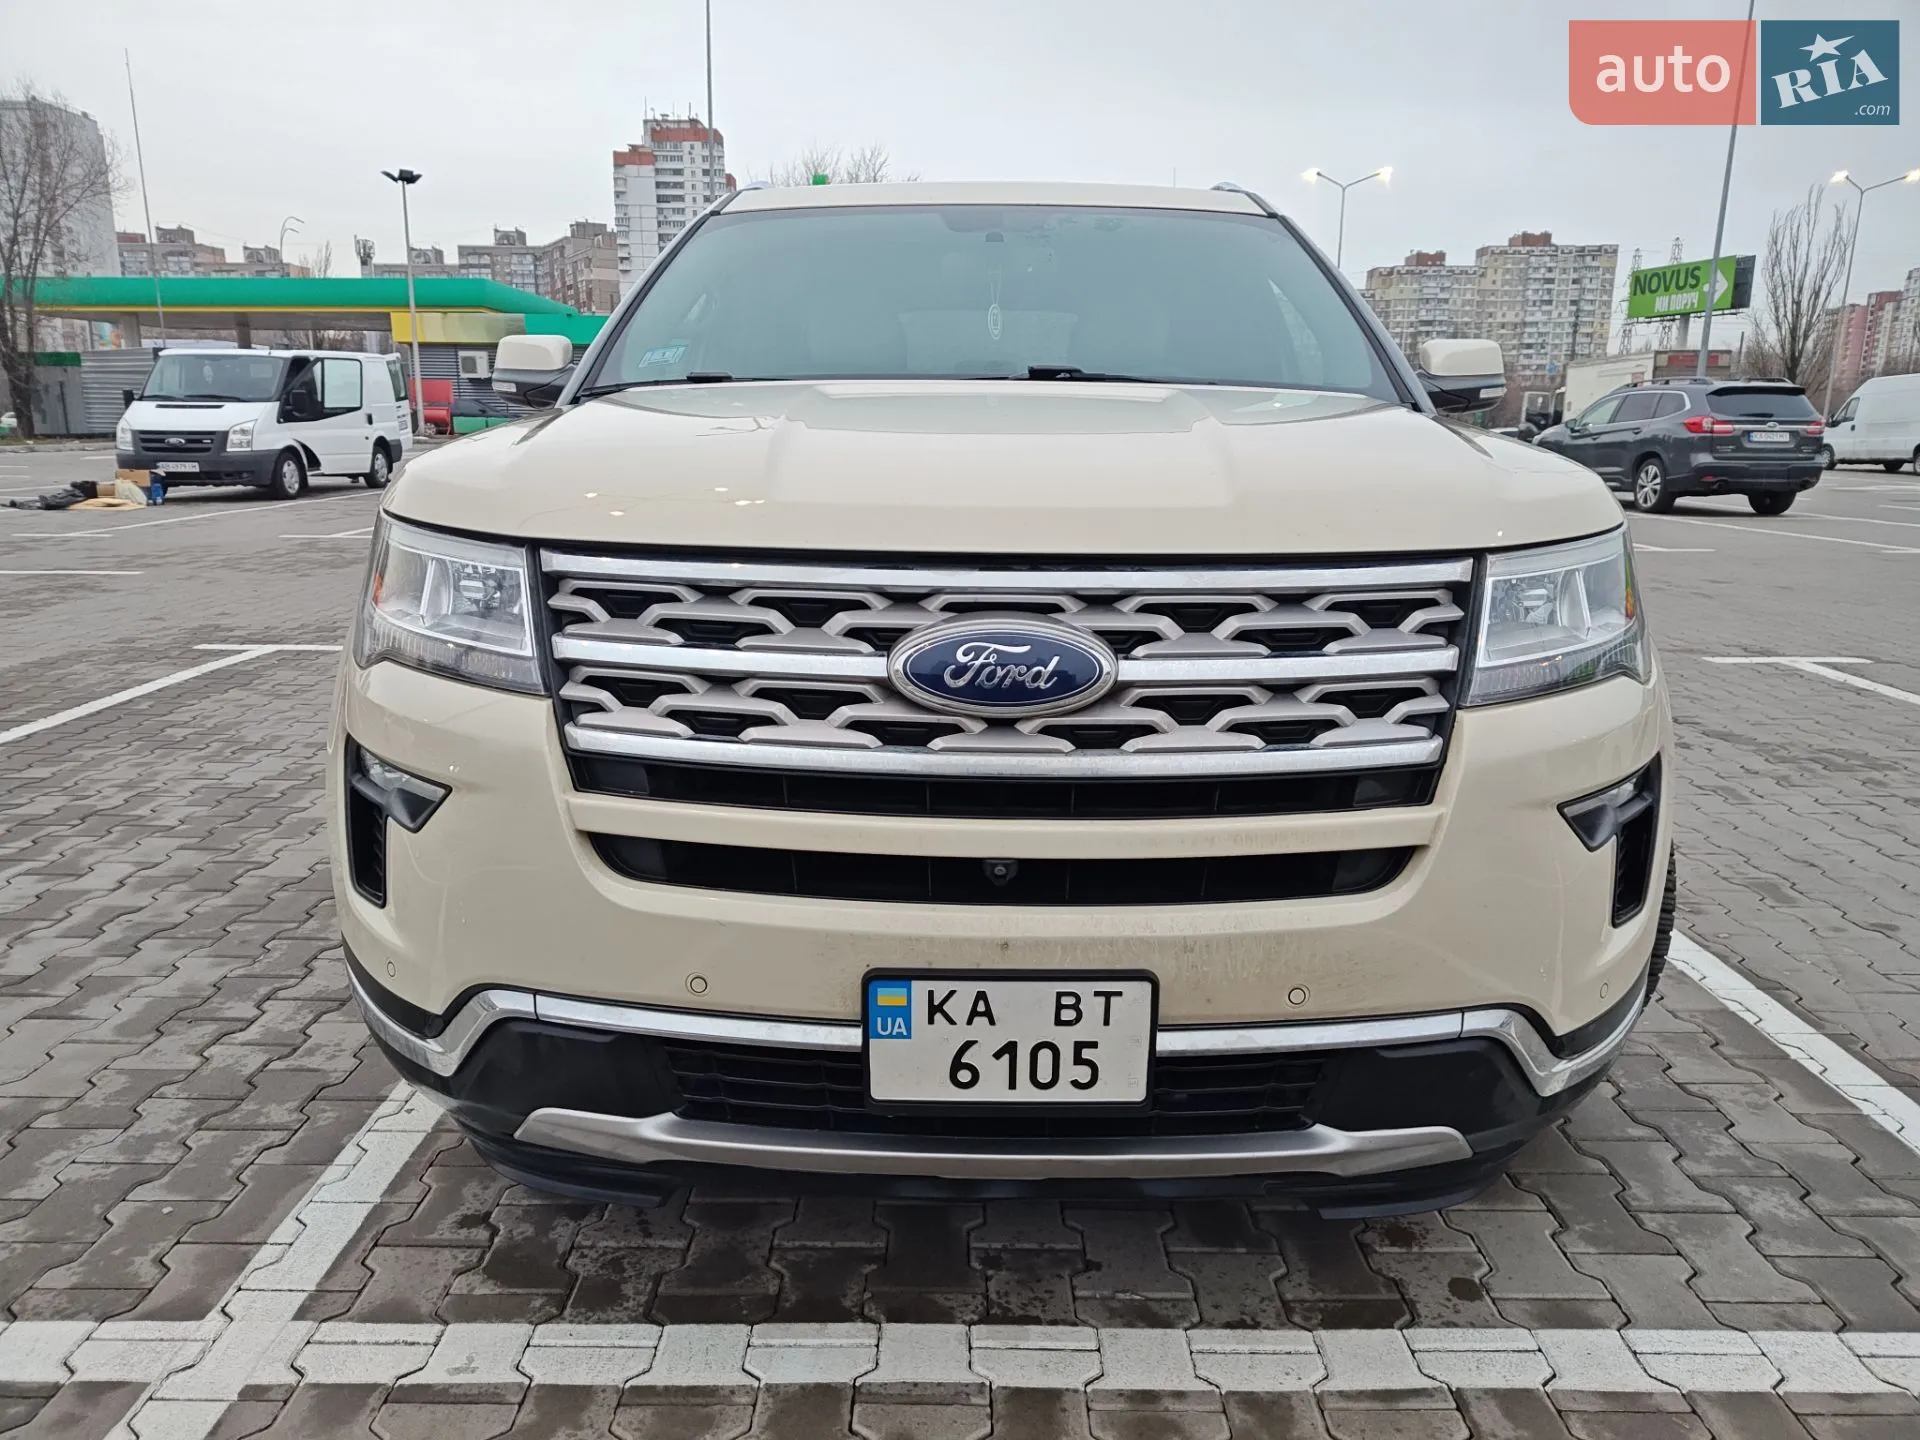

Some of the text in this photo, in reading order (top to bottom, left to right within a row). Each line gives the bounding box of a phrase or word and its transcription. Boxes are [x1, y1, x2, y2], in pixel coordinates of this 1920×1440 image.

[1633, 266, 1701, 296] NOVUS
[943, 641, 1061, 690] Ford
[876, 1016, 908, 1036] UA
[927, 989, 1123, 1027] KA BT
[949, 1039, 1100, 1091] 6105
